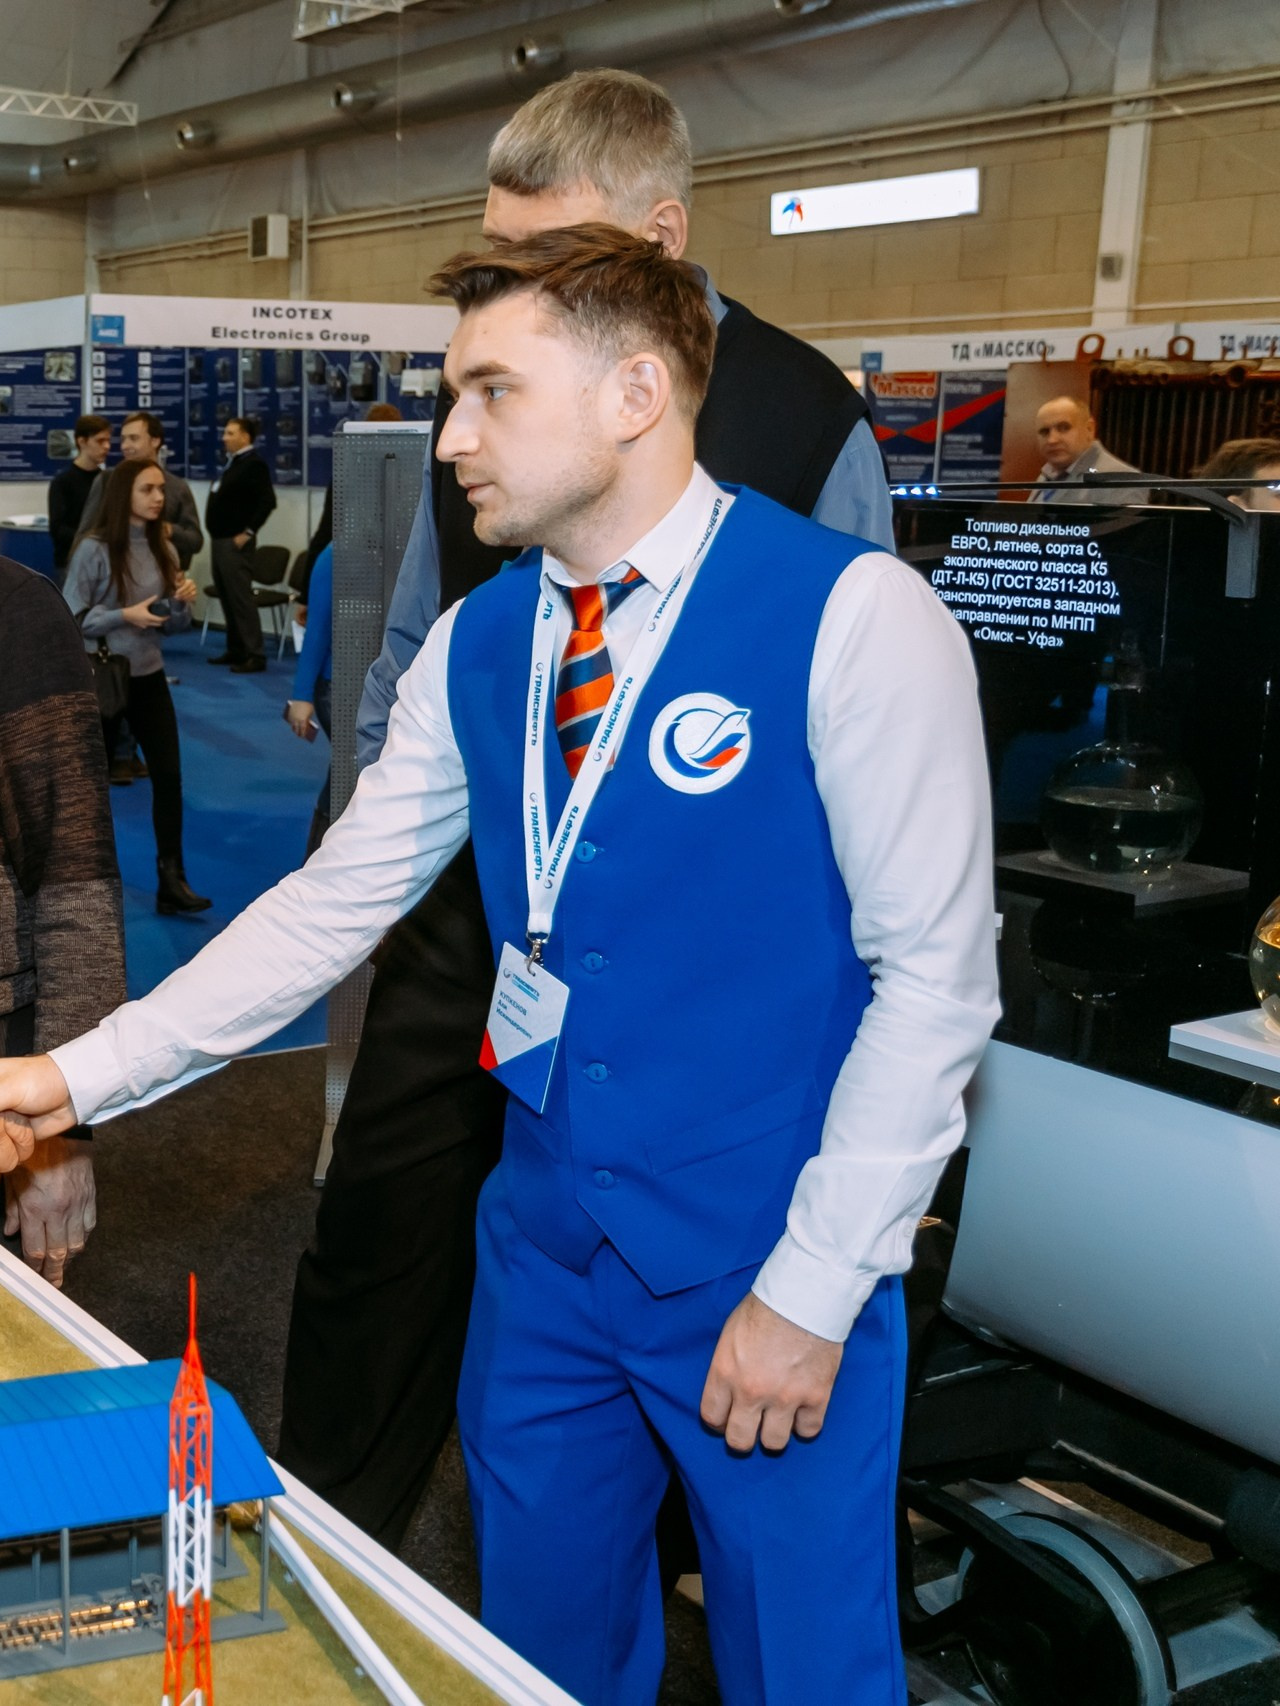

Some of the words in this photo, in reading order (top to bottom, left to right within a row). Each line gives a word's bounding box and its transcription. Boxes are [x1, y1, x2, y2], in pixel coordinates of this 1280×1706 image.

[252, 306, 332, 321] INCOTEX
[211, 326, 314, 342] Electronics
[319, 329, 371, 344] Group
[951, 343, 970, 361] ТД
[974, 339, 1055, 358] «МАССКО»
[877, 382, 935, 397] Massco
[965, 518, 1018, 534] Топливо
[1019, 523, 1090, 537] дизельное
[951, 535, 991, 553] ЕВРО,
[994, 540, 1042, 555] летнее,
[1046, 543, 1084, 558] сорта
[1087, 542, 1102, 559] С,
[943, 556, 1038, 572] экологического
[1041, 561, 1087, 575] класса
[1090, 561, 1108, 576] К5
[931, 569, 989, 590] (ДТ-Л-К5)
[992, 573, 1033, 591] (ГОСТ
[1035, 577, 1120, 599] 32511-2013).
[1043, 599, 1051, 610] в
[1054, 600, 1121, 615] западном
[1032, 615, 1048, 628] по
[1051, 615, 1095, 632] МНПП
[973, 626, 1014, 643] «Омск
[1027, 631, 1064, 649] Уфа»
[531, 673, 543, 746] ТРАНСНЕФТЬ
[597, 676, 633, 750] ТРАНСНЕФТЬ
[530, 804, 543, 881] ТРАНСНЕФТЬ
[548, 805, 580, 878] ТРАНСНЕФТЬ
